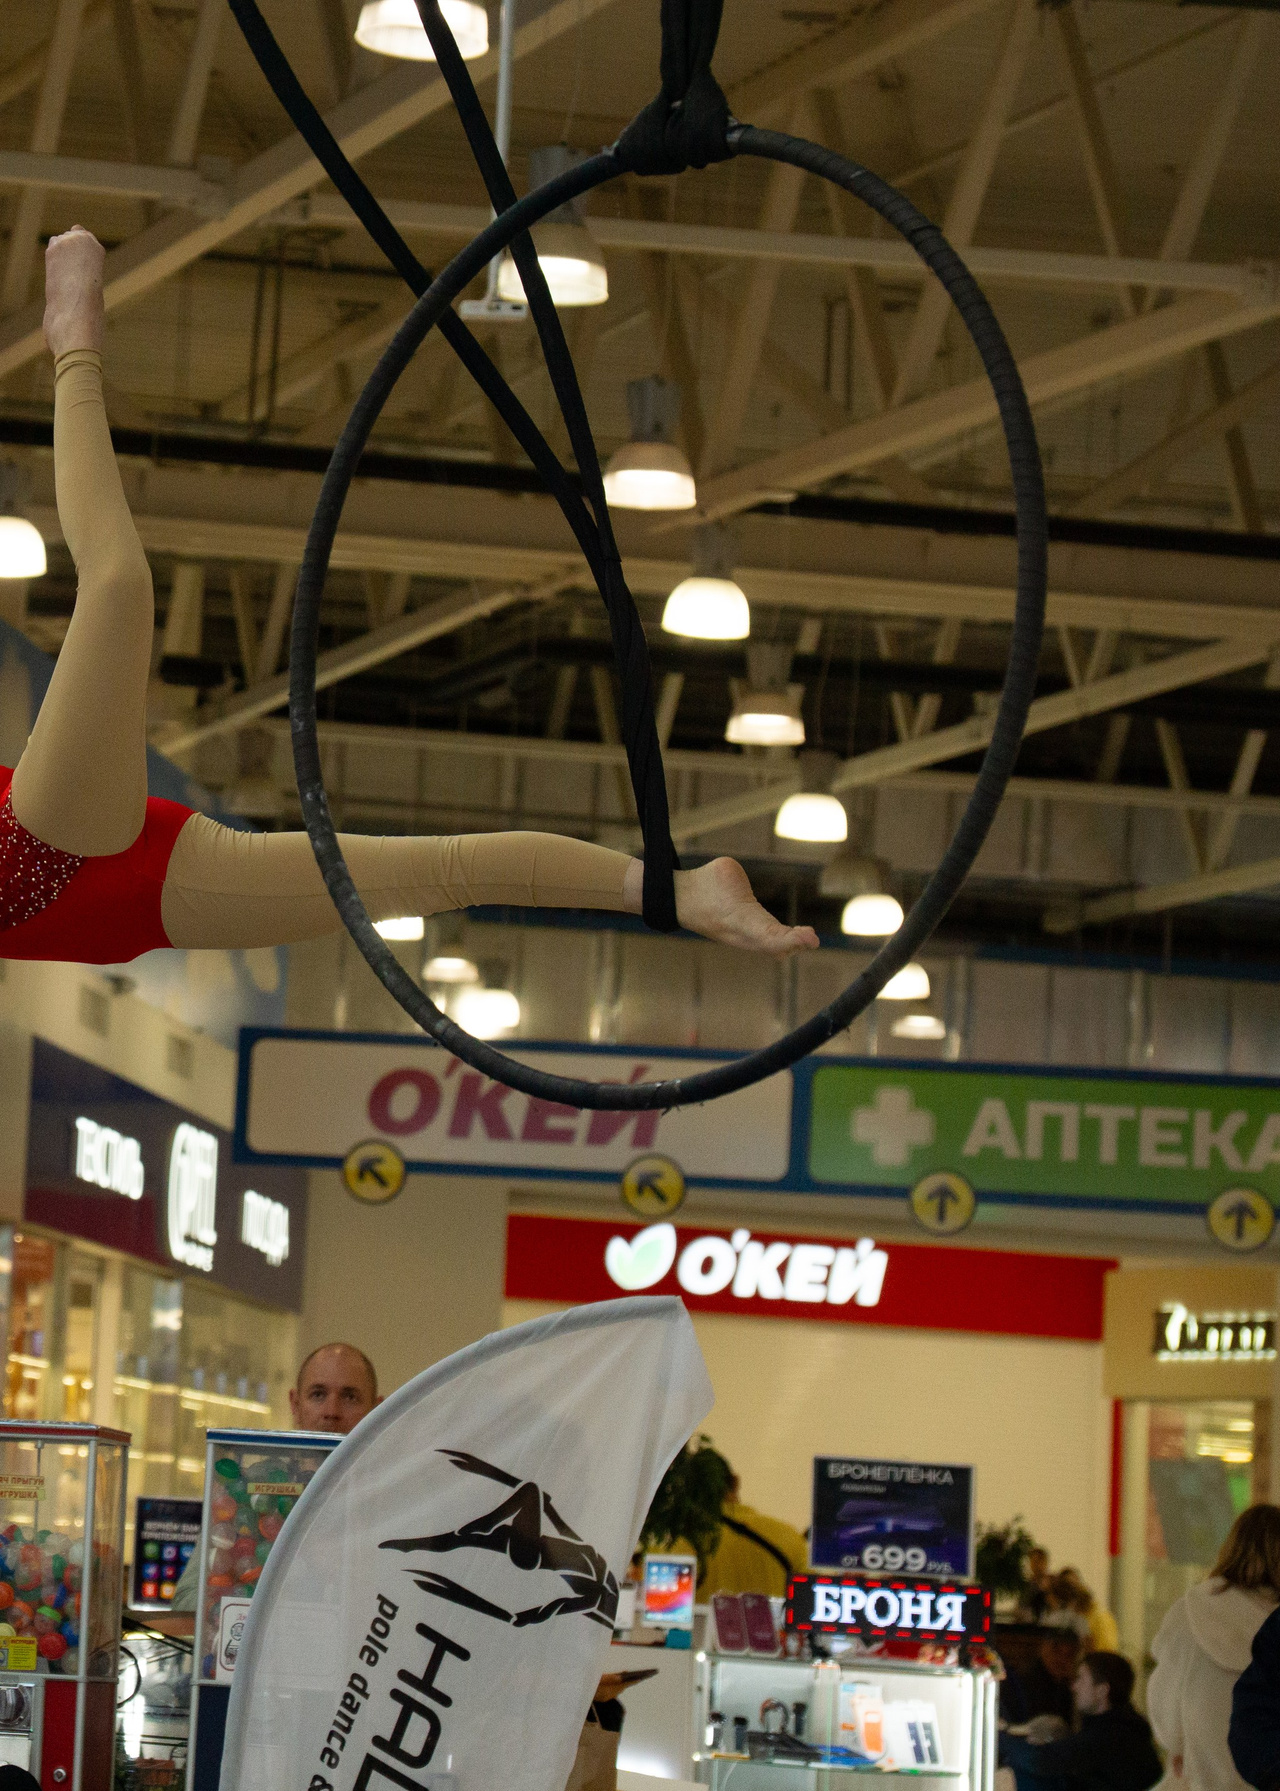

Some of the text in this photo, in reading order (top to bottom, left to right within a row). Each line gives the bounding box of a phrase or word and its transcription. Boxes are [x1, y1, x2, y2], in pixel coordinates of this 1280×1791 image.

[962, 1098, 1280, 1172] АПТЕКА
[254, 1484, 297, 1495] ИГРУШКА
[862, 1543, 927, 1573] 699
[359, 1593, 400, 1668] pole
[810, 1583, 968, 1632] БРОНЯ
[320, 1672, 371, 1770] dance
